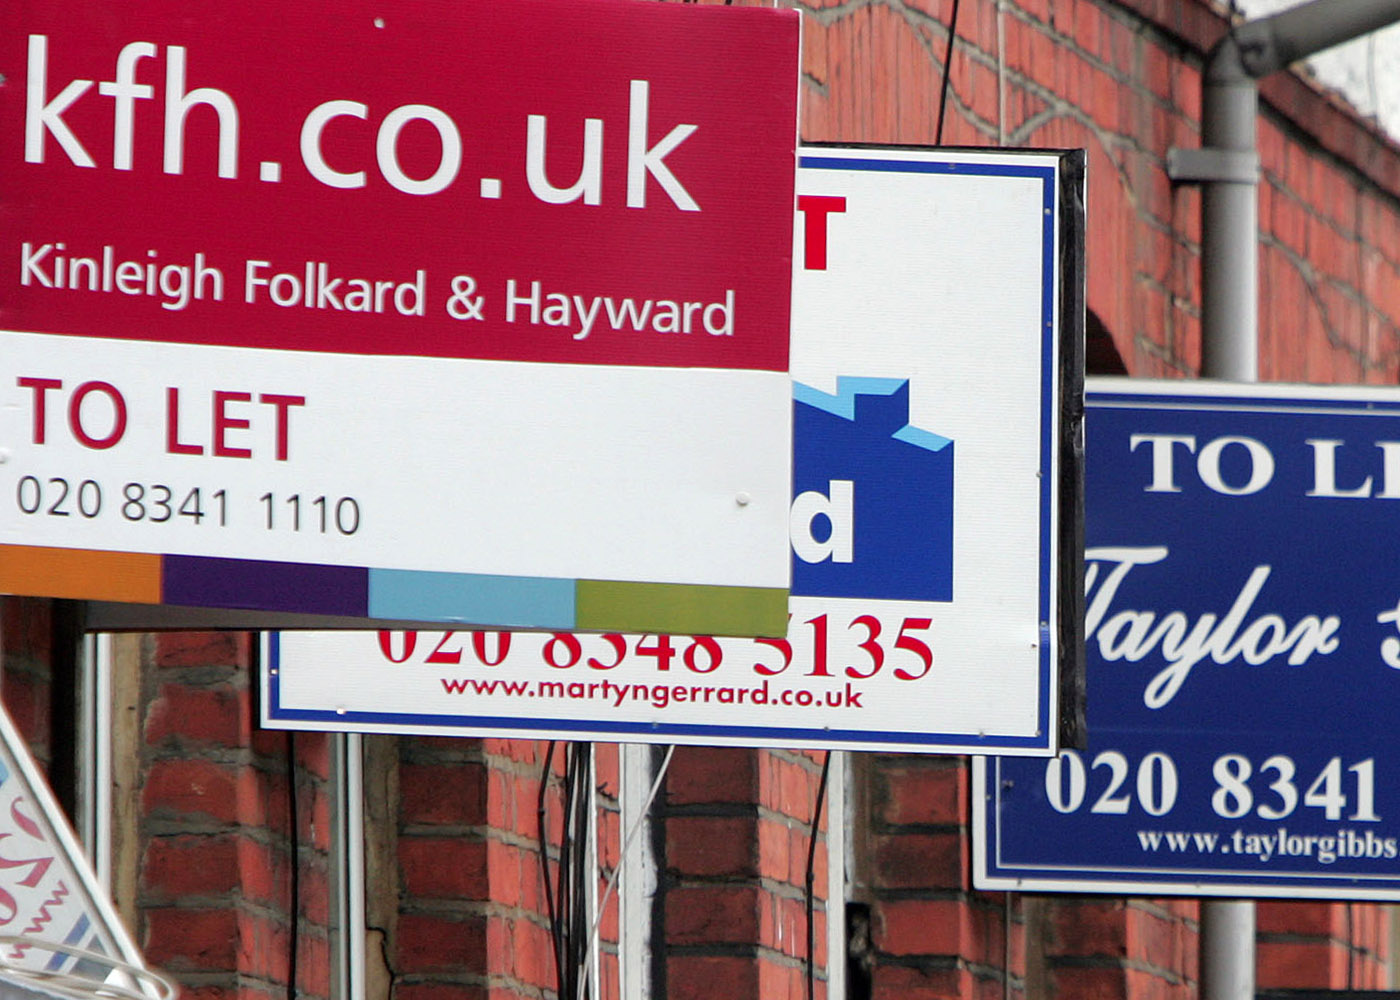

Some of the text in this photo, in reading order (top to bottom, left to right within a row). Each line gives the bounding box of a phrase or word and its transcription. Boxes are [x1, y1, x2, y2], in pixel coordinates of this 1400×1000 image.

[23, 34, 702, 212] kfh.co.uk
[20, 242, 735, 340] Kinleigh Folkard & Hayward
[16, 376, 306, 461] TO LET
[1130, 434, 1273, 495] TO
[16, 475, 361, 536] 020 8341 1110
[753, 613, 933, 682] 5135
[1084, 547, 1340, 709] Taylor
[441, 676, 863, 709] www.martyngerrard.co.uk
[1044, 751, 1178, 816] 020
[1210, 754, 1381, 822] 8341
